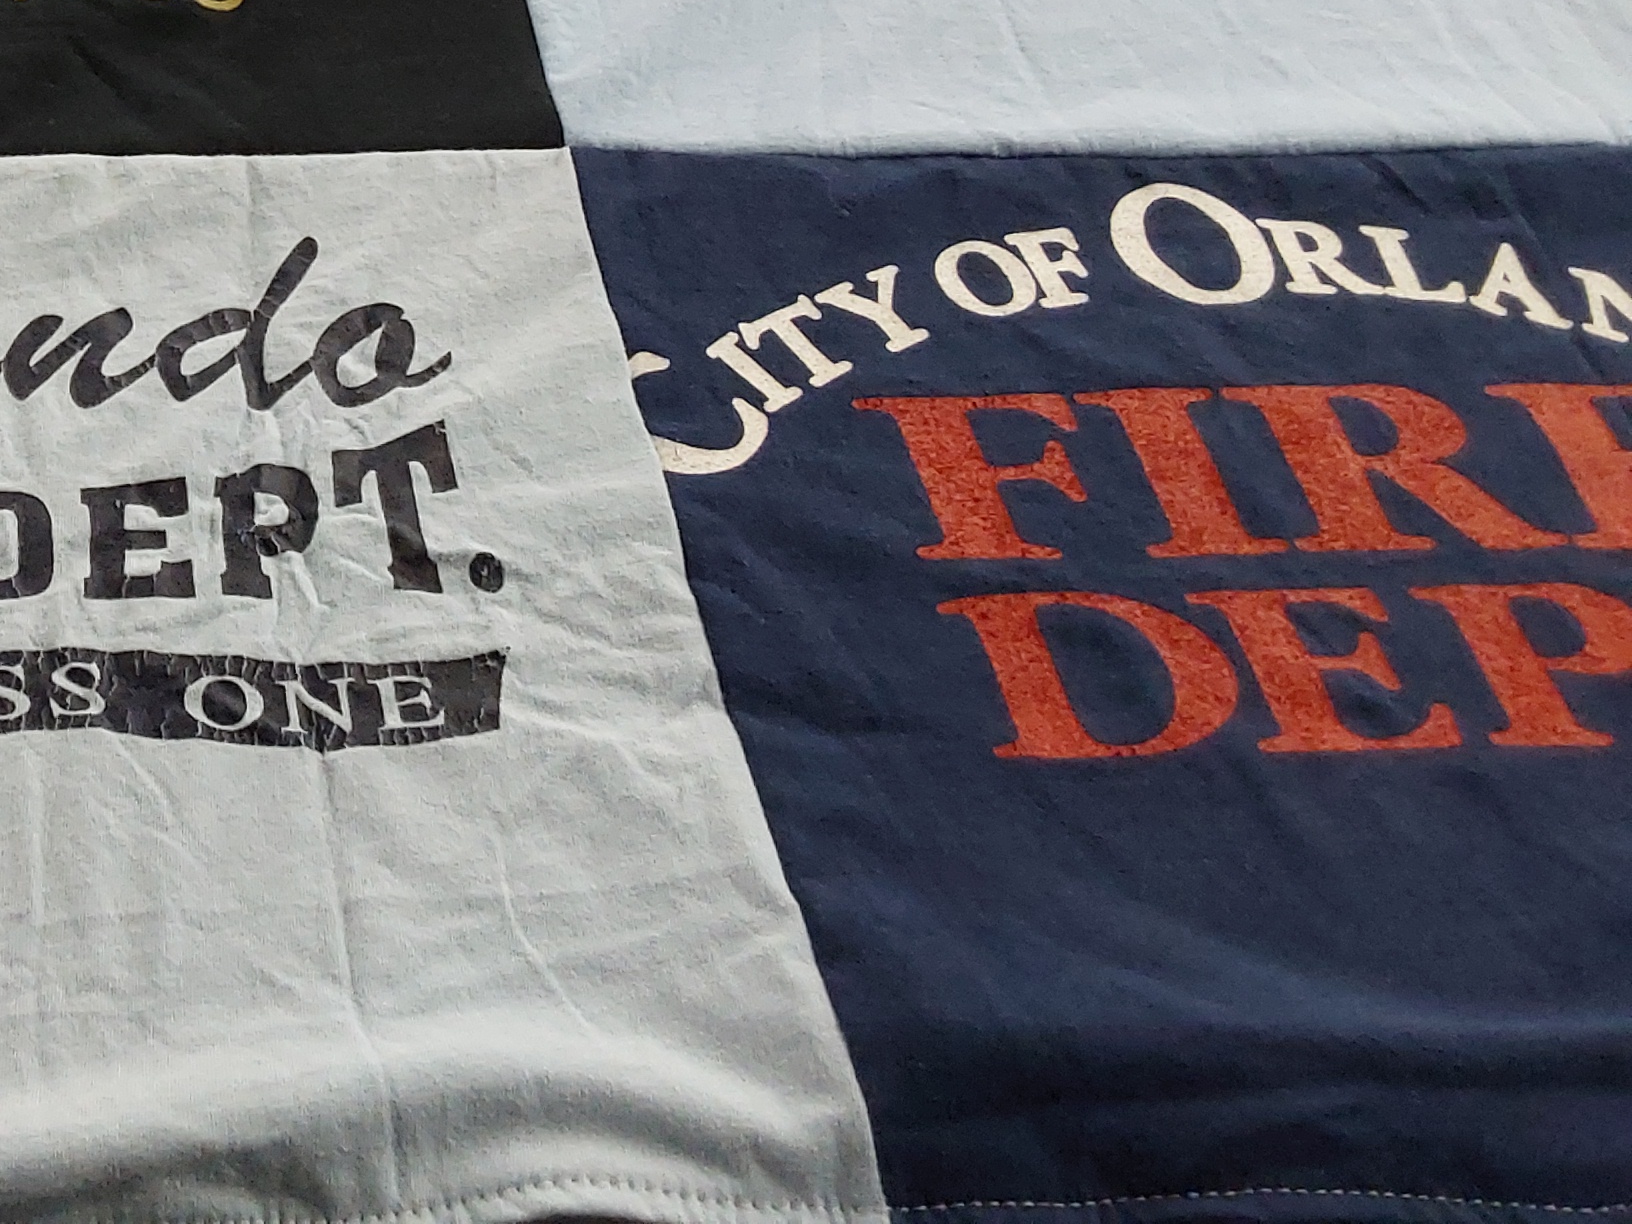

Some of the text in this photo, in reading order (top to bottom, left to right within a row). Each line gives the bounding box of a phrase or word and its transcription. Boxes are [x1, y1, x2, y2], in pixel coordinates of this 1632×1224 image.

[629, 263, 932, 477] CITY
[933, 225, 1091, 318] OF
[180, 671, 448, 734] ONE
[936, 581, 1632, 762] DEP
